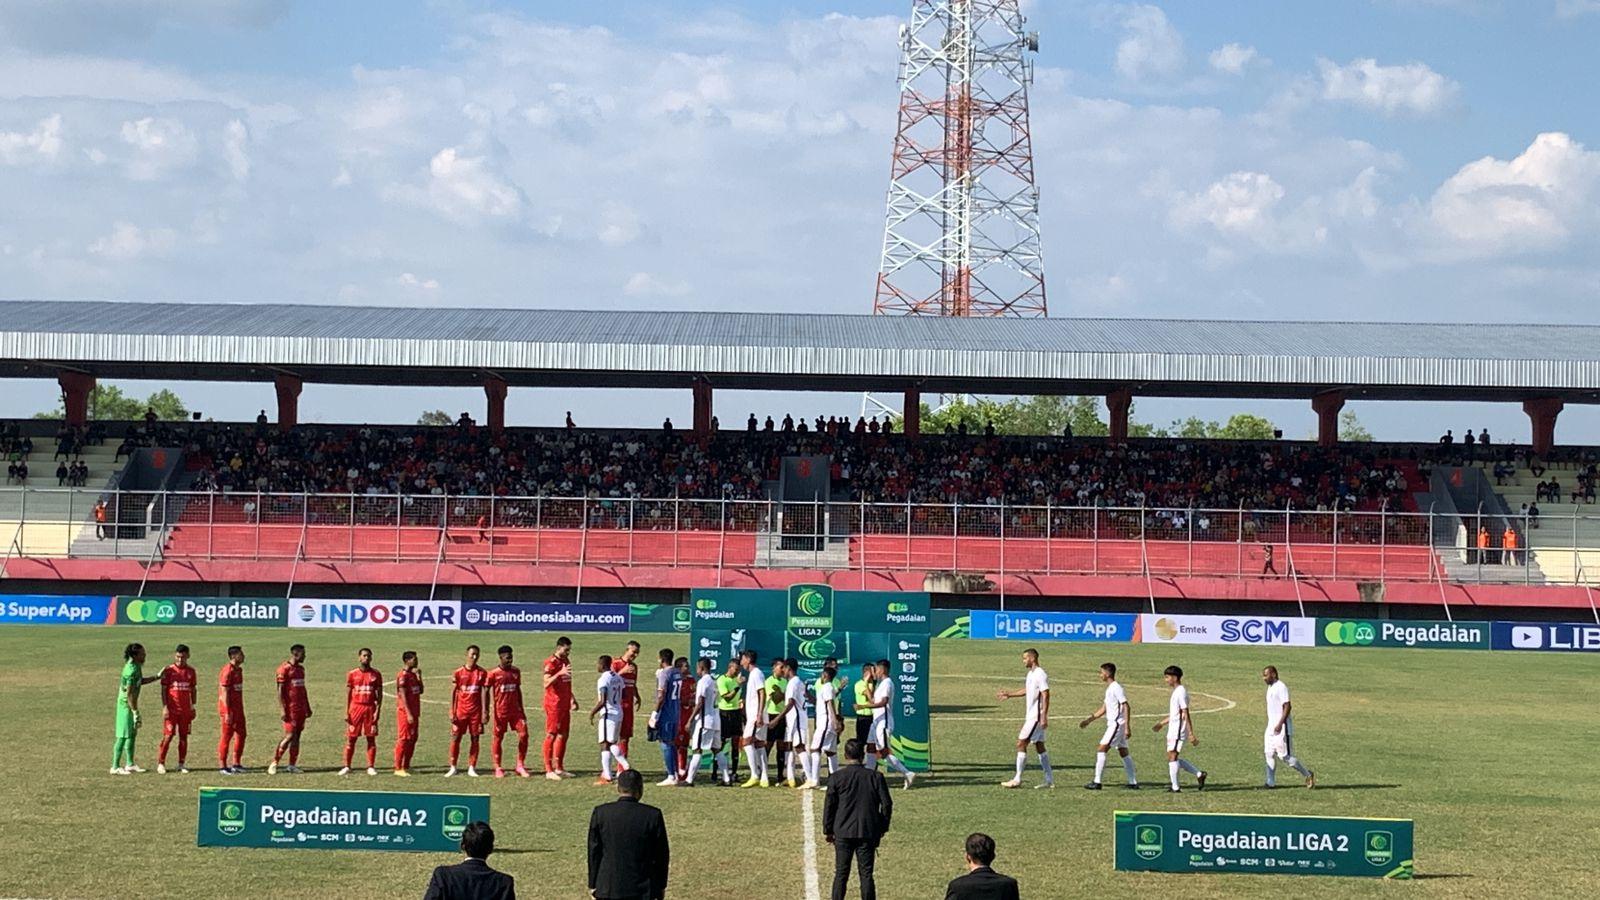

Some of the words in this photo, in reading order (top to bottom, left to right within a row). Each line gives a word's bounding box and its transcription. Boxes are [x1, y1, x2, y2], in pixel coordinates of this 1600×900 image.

[8, 602, 56, 620] Super
[57, 603, 92, 621] App
[183, 600, 280, 623] Pegadaian
[320, 604, 456, 625] INDOSIAR
[482, 610, 625, 625] ligaindonesiabaru.com
[695, 609, 735, 620] Pegadaian
[886, 613, 926, 624] Pegadaian
[791, 617, 830, 627] Pegadaian
[1006, 619, 1031, 633] LIB
[1033, 619, 1082, 637] Super
[1082, 620, 1117, 638] App
[1180, 625, 1207, 634] Emtek
[1220, 619, 1290, 643] SCM
[798, 628, 816, 636] LIGA
[1382, 622, 1481, 646] Pegadaian
[1549, 626, 1600, 649] LIB
[260, 805, 361, 829] Pegadaian
[366, 807, 412, 826] LIGA
[414, 809, 428, 827] 2
[1178, 829, 1280, 853] Pegadaian
[1286, 832, 1333, 851] LIGA
[1336, 835, 1349, 852] 2
